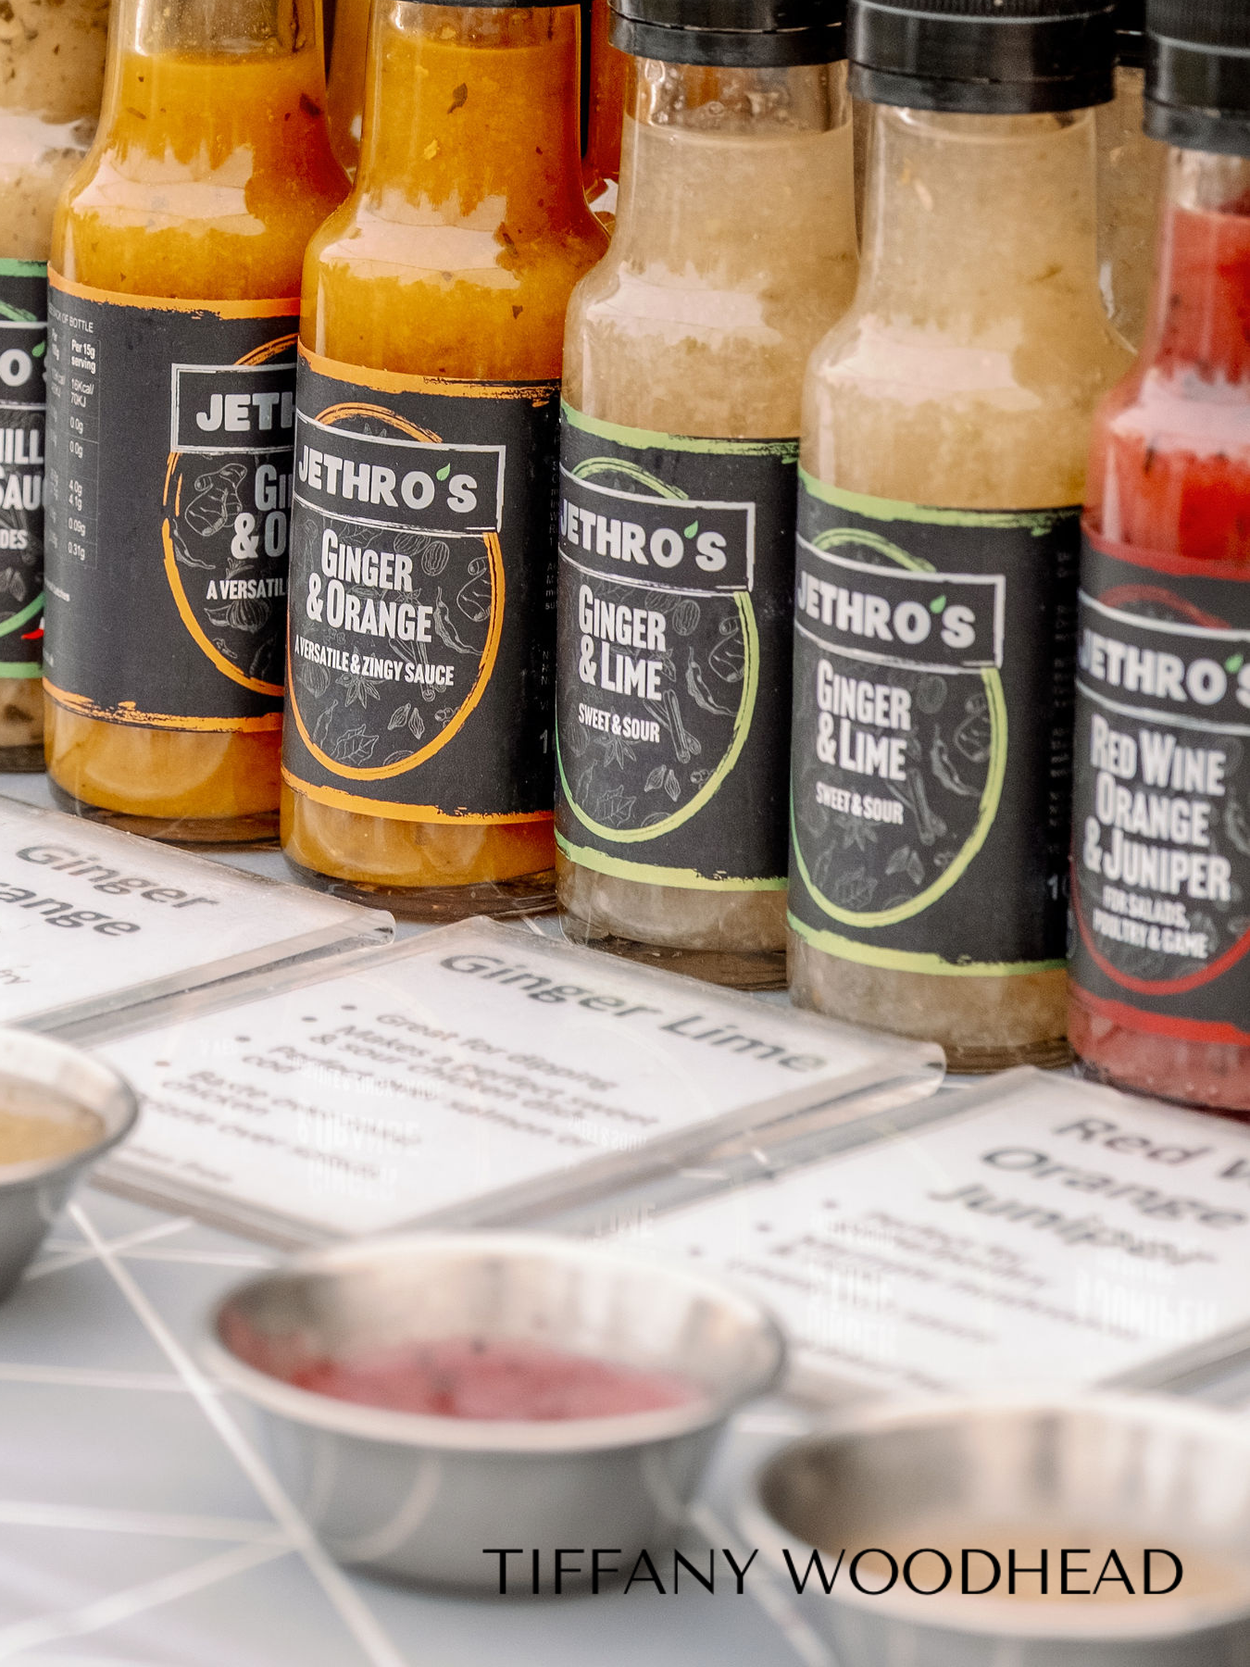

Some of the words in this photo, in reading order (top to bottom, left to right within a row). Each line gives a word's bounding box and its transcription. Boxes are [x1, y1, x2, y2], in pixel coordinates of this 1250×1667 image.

[69, 315, 94, 333] BOTTLE
[71, 339, 82, 353] Per
[83, 342, 96, 360] 15g
[71, 356, 96, 374] serving
[298, 446, 478, 514] JETHRO'S
[231, 512, 259, 560] &
[321, 528, 413, 593] GINGER
[559, 499, 728, 572] JETHRO'S
[206, 579, 218, 601] A
[220, 577, 288, 600] VERSATIL
[326, 579, 433, 643] ORANGE
[578, 583, 667, 653] GINGER
[797, 569, 976, 650] JETHRO'S
[300, 637, 349, 672] VERSATILE
[350, 653, 361, 675] &
[362, 654, 404, 682] ZINGY
[404, 662, 455, 686] SAUCE
[578, 634, 597, 686] &
[600, 651, 663, 703] LIME
[577, 701, 610, 734] SWEET
[611, 712, 621, 737] &
[622, 714, 661, 744] SOUR
[815, 658, 913, 732] GINGER
[815, 713, 837, 766] &
[838, 730, 908, 784] LIME
[1091, 713, 1137, 780] RED
[1138, 728, 1227, 797] WINE
[814, 780, 851, 816] SWEET
[851, 792, 863, 818] &
[863, 794, 905, 826] SOUR
[1096, 770, 1211, 847] ORANGE
[16, 845, 220, 909] Ginger
[1083, 814, 1103, 874] &
[1103, 827, 1232, 902] JUNIPER
[1102, 883, 1128, 916] FOR
[1093, 907, 1146, 950] POULTRY
[1162, 926, 1210, 959] GAME
[440, 954, 662, 1020] Ginger
[659, 1014, 829, 1073] Lime
[1053, 1117, 1214, 1166] Red
[981, 1145, 1248, 1230] Orange
